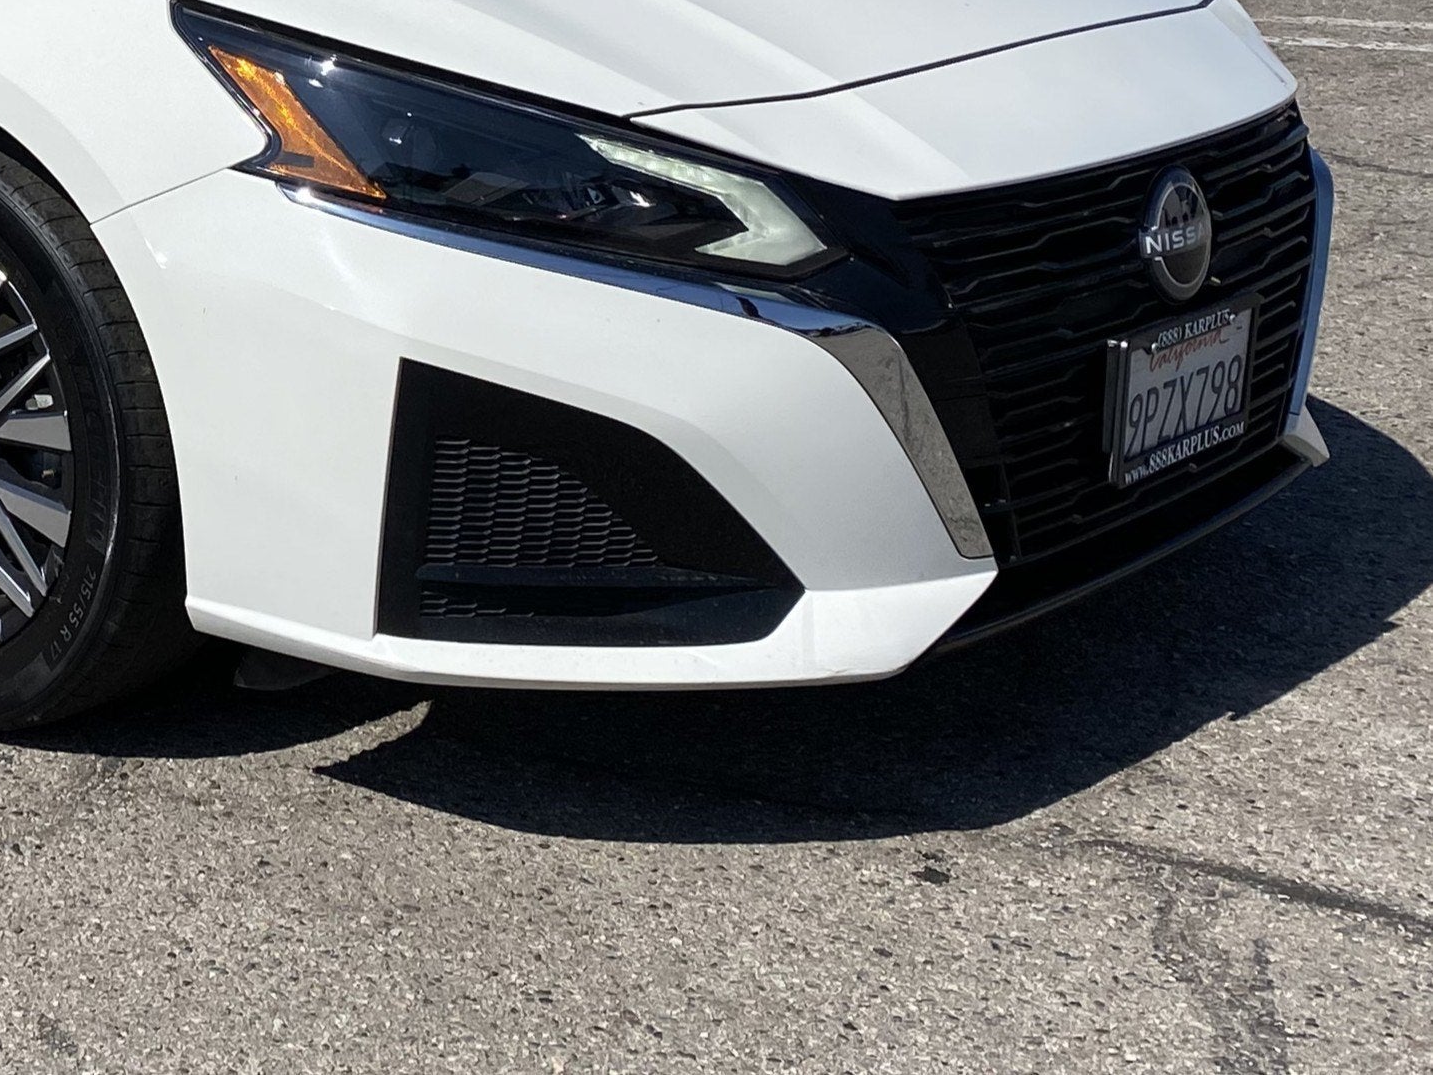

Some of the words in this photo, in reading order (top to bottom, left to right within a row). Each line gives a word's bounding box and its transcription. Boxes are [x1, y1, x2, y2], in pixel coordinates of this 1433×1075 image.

[1124, 354, 1243, 463] 9PZX798
[69, 562, 98, 629] 215/55
[49, 639, 63, 662] 17
[59, 624, 73, 643] R
